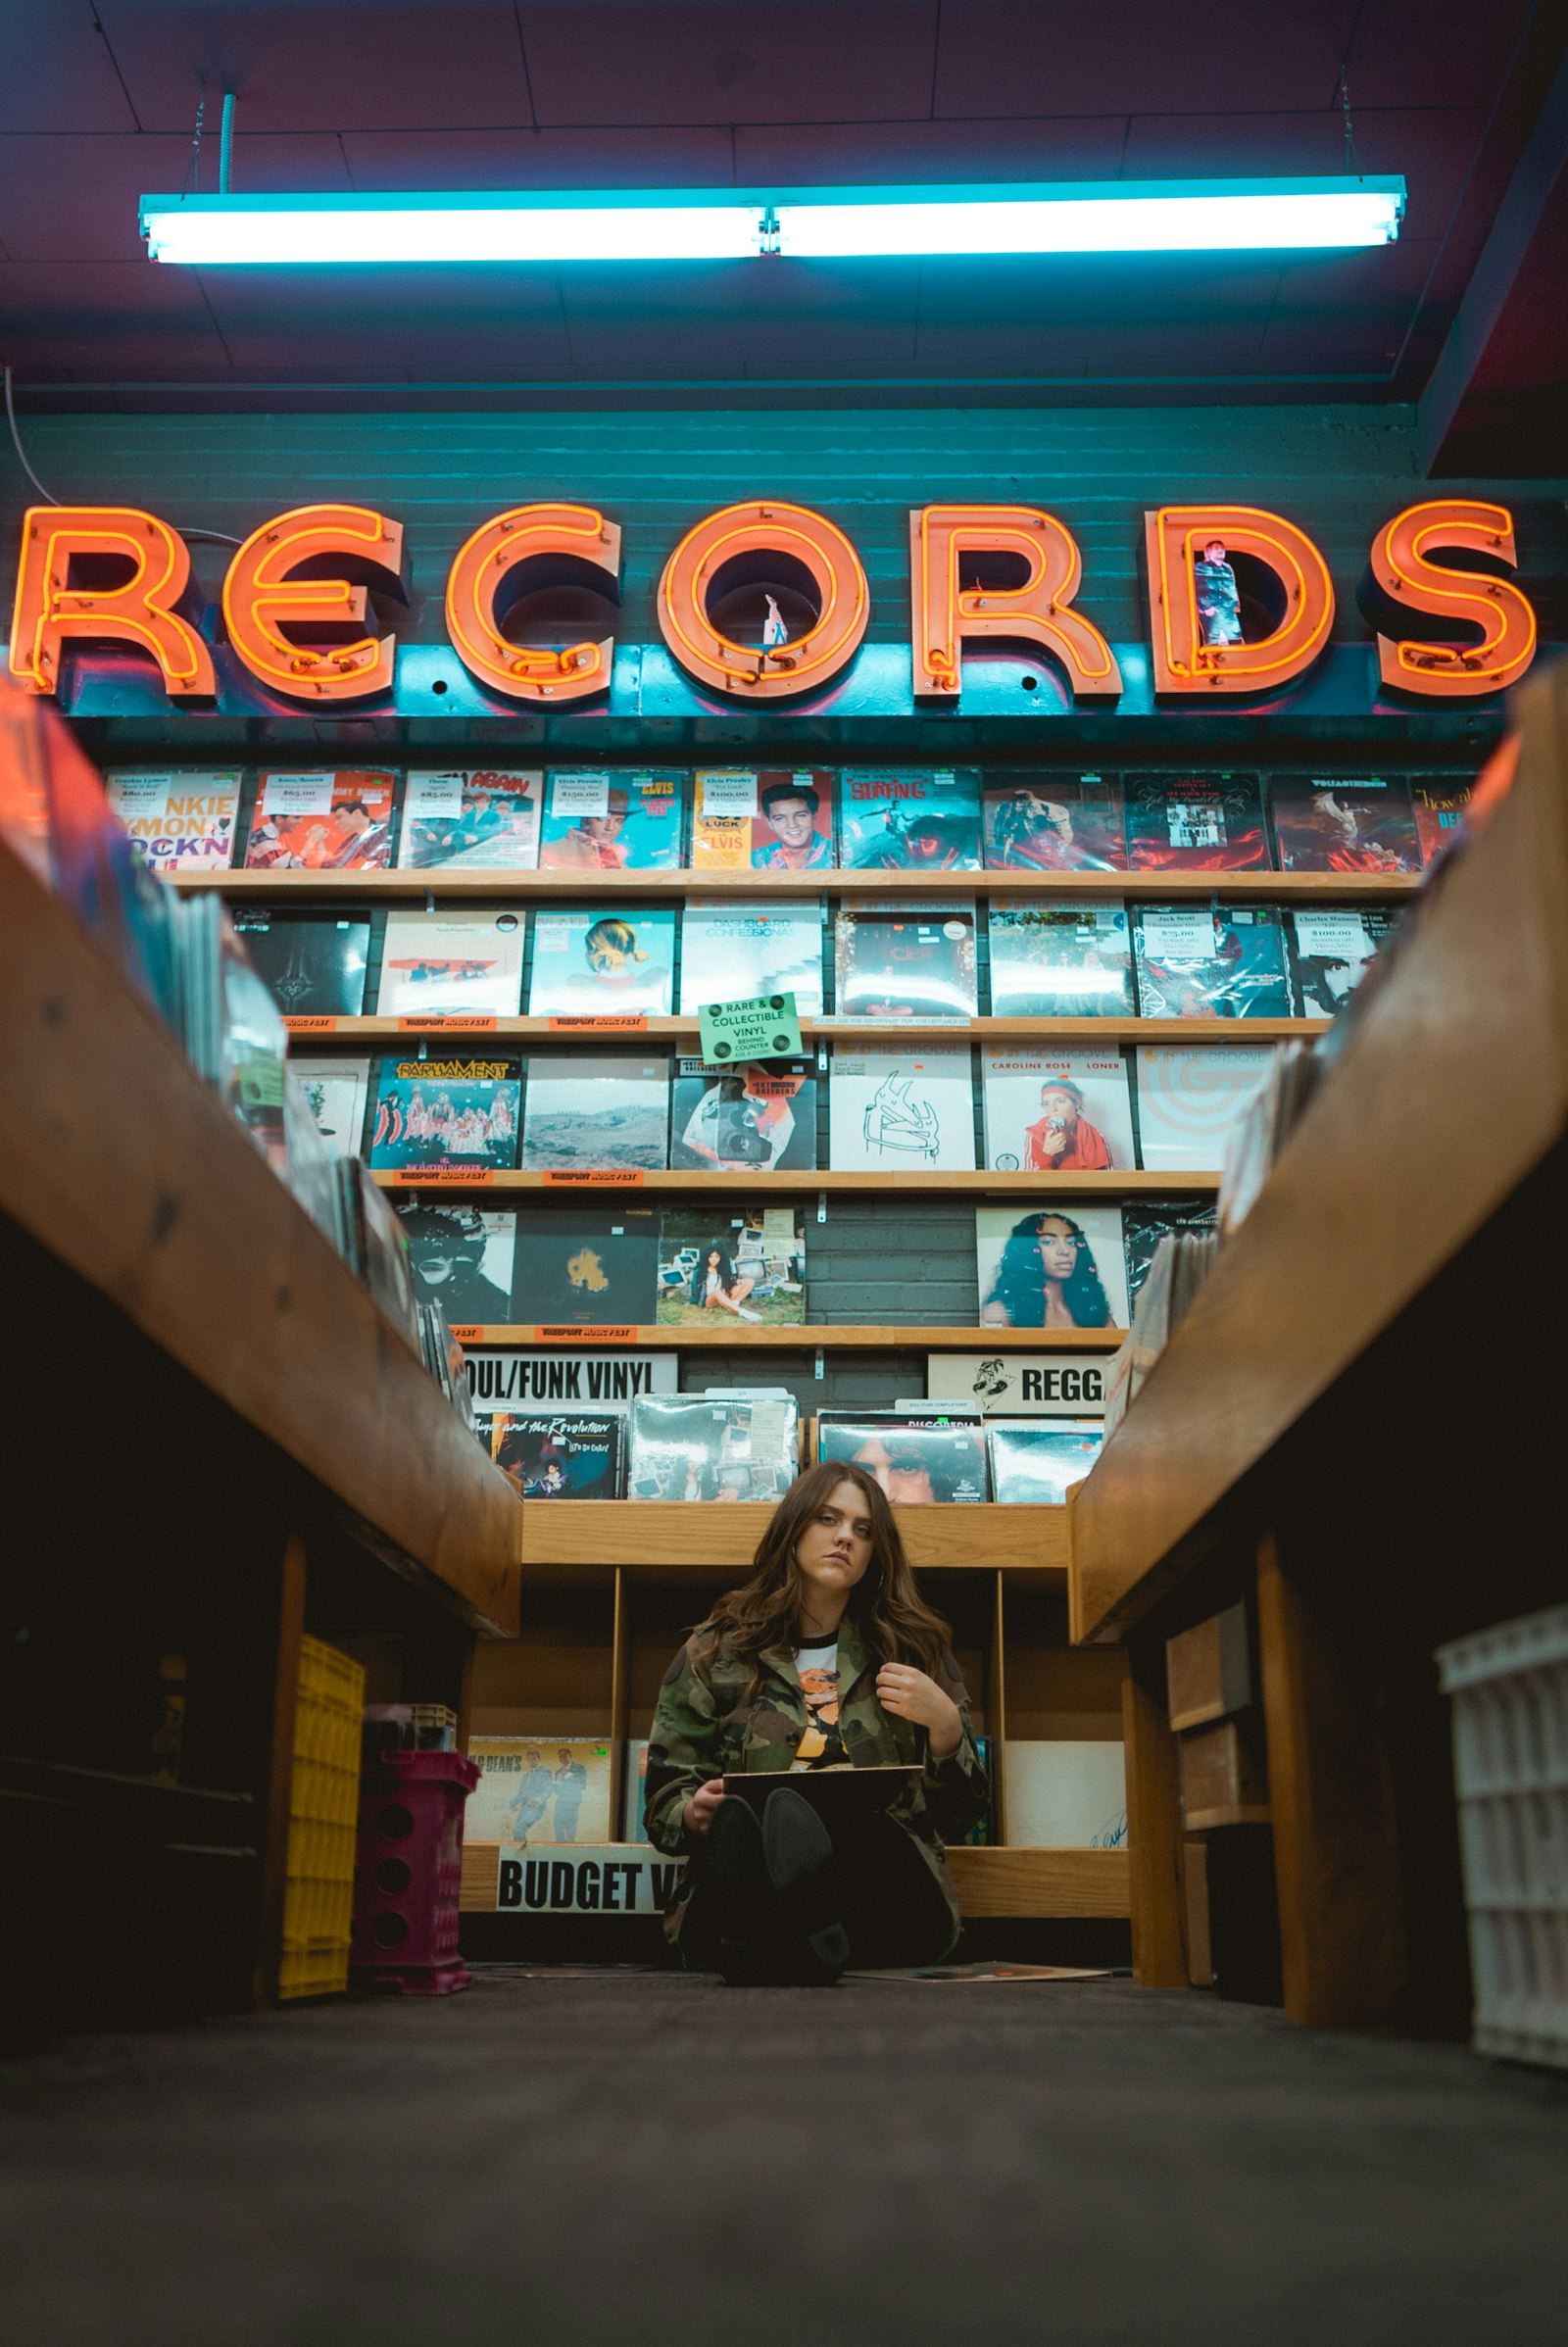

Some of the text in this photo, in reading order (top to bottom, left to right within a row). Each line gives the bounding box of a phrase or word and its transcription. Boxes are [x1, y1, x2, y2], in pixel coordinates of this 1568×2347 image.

[10, 499, 1537, 700] RECORDS
[470, 771, 529, 795] AGAIN
[641, 782, 674, 795] ELVIS
[166, 796, 234, 816] NKIE
[703, 837, 744, 850] ELVIS
[726, 1000, 766, 1012] RARE &
[712, 1010, 784, 1027] COLLECTIBLE
[733, 1026, 766, 1037] VINYL
[735, 1042, 768, 1051] COUNTER
[1163, 1051, 1265, 1063] IN THE GROOVE
[396, 1059, 510, 1081] PARLIAMENT
[586, 1361, 653, 1399] VINYL
[1022, 1368, 1105, 1401] REGG
[503, 1421, 528, 1433] and
[529, 1420, 549, 1433] the
[548, 1418, 611, 1440] Revolution
[486, 1754, 521, 1773] DEAN'S
[499, 1860, 686, 1911] BUDGET V
